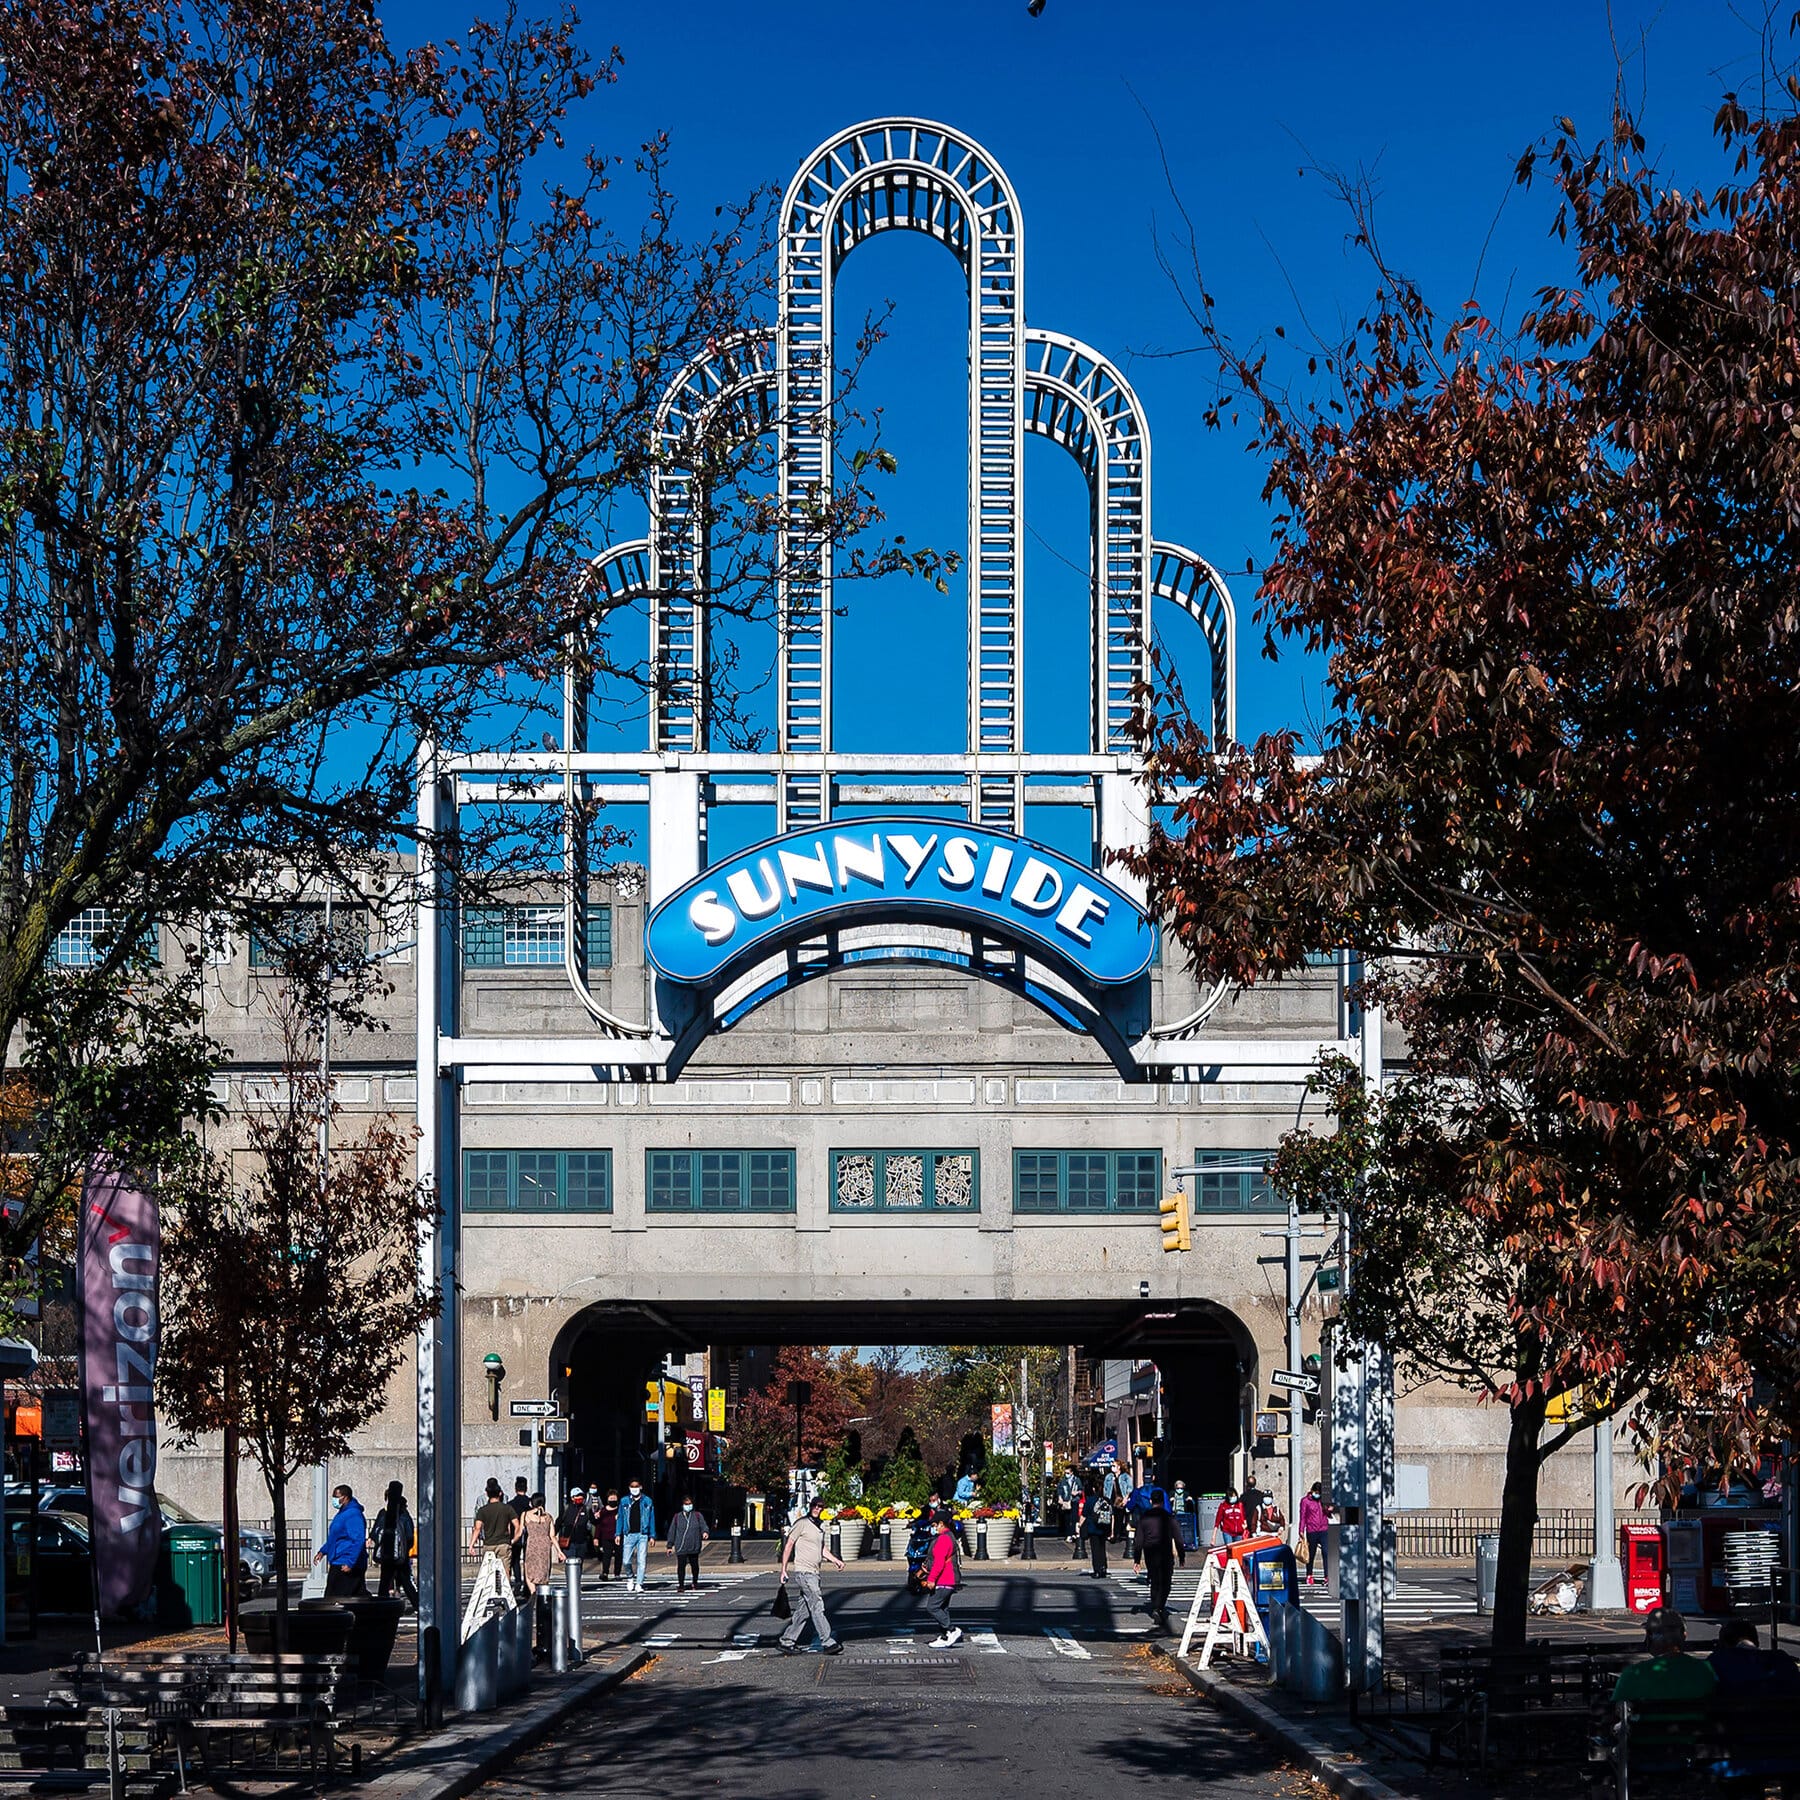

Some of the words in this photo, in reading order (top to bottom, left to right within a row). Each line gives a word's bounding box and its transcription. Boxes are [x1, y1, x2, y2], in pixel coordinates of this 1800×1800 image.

[689, 833, 1110, 945] SUNNYSIDE
[691, 1383, 703, 1391] 46
[1298, 1379, 1313, 1387] WAY
[103, 1243, 156, 1534] verizon
[1634, 1588, 1660, 1597] IMPACTO
